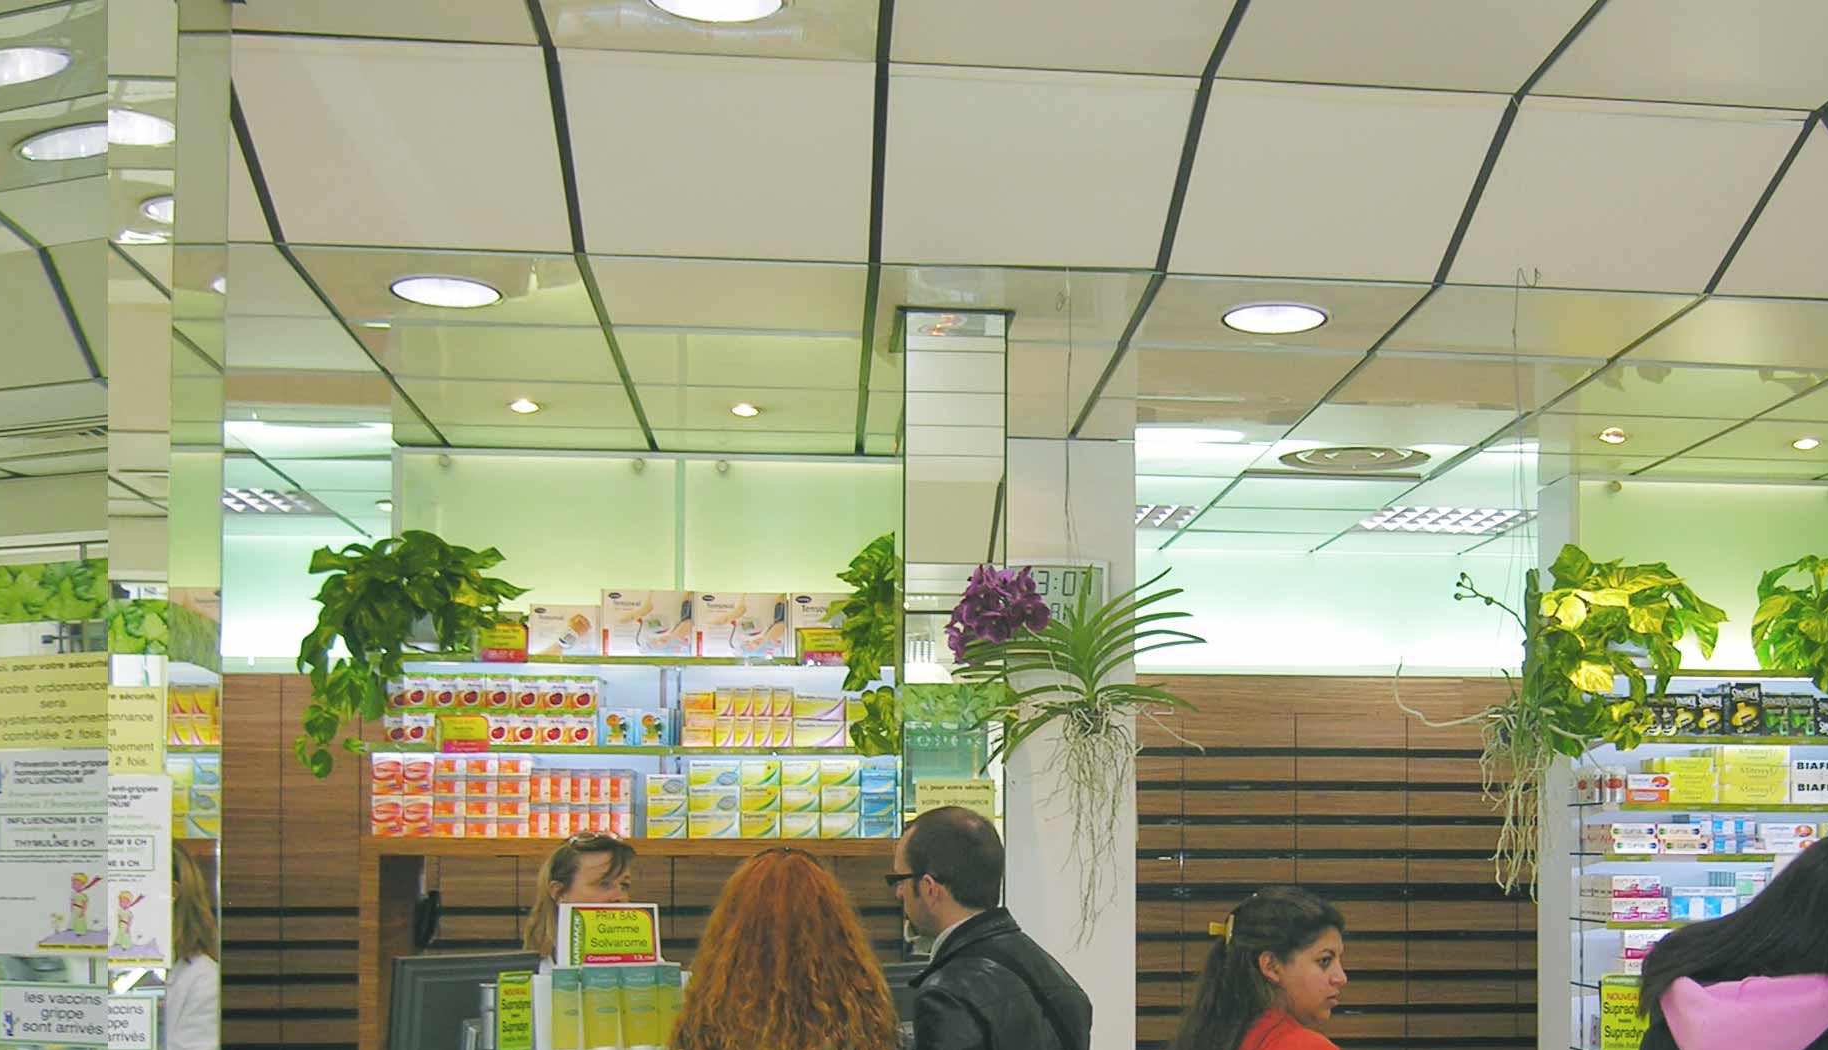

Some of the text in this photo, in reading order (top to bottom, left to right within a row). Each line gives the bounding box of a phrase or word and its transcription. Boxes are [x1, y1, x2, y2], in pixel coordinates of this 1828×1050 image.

[0, 683, 29, 694] votre
[40, 698, 67, 708] sera
[64, 730, 73, 740] 2
[597, 924, 640, 935] Gamme
[590, 937, 648, 949] Solvarome
[24, 990, 103, 1006] les vaccins
[41, 1008, 85, 1023] grippe
[22, 1020, 105, 1035] sont arrivés
